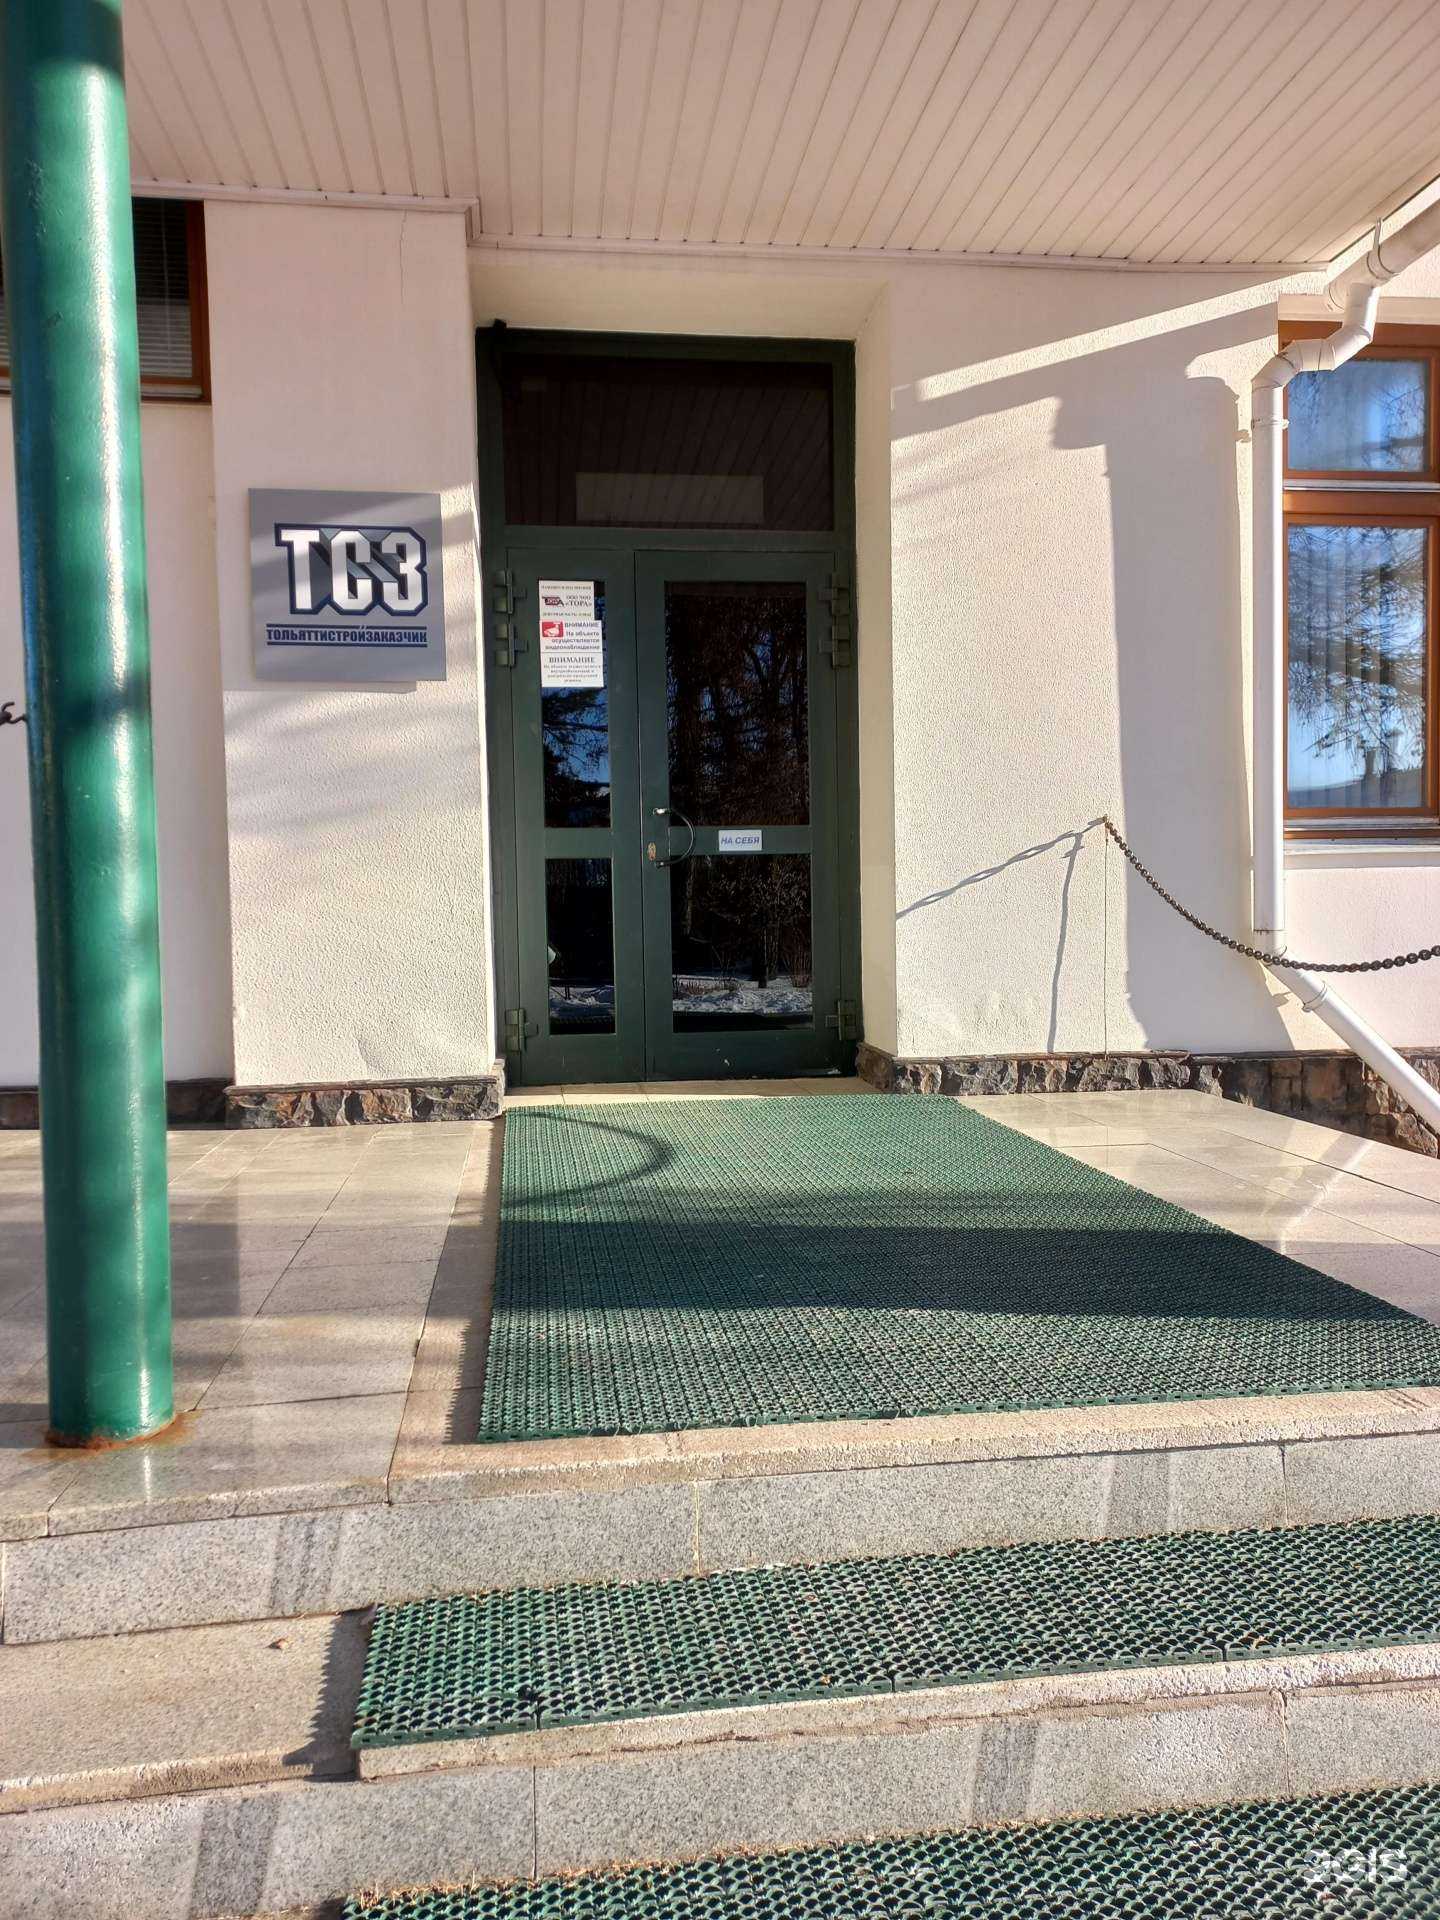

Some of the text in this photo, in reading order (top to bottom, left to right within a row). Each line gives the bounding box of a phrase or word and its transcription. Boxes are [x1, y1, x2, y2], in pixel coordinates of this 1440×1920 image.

[276, 525, 428, 615] ТСЗ
[266, 626, 427, 643] ТОЛЬЯТТИСТРОЙЗАКАЗЧИК
[735, 836, 760, 844] СЕБЯ
